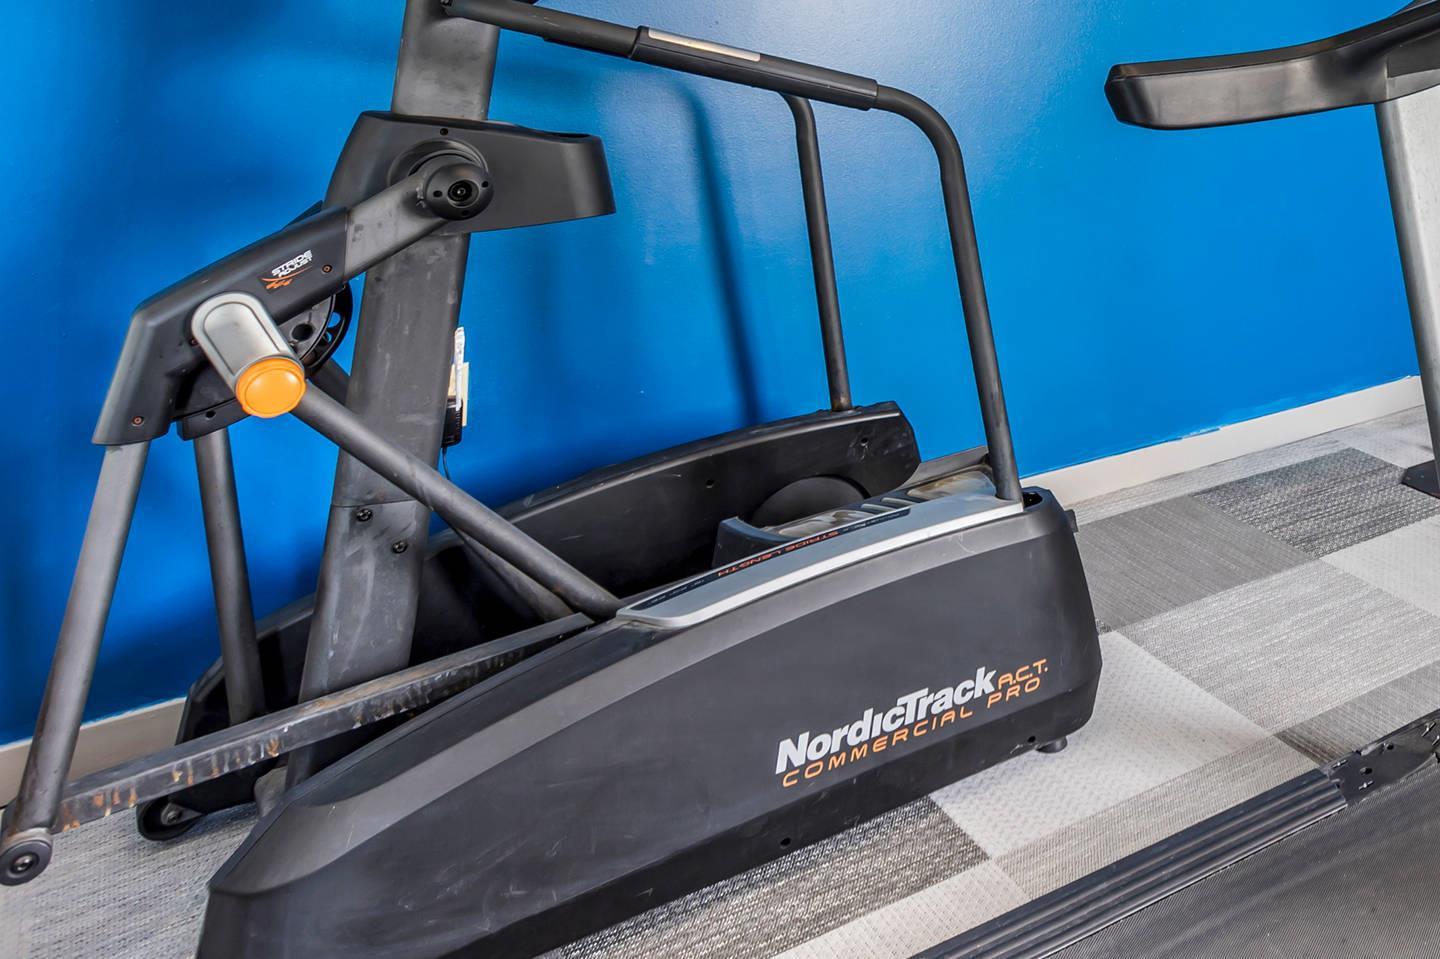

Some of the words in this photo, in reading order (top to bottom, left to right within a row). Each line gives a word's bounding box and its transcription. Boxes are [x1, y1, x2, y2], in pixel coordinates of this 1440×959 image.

[271, 249, 313, 276] STRIDE
[775, 666, 999, 775] NordicTrack
[781, 707, 974, 789] COMMERCIAL
[986, 677, 1041, 709] PRO
